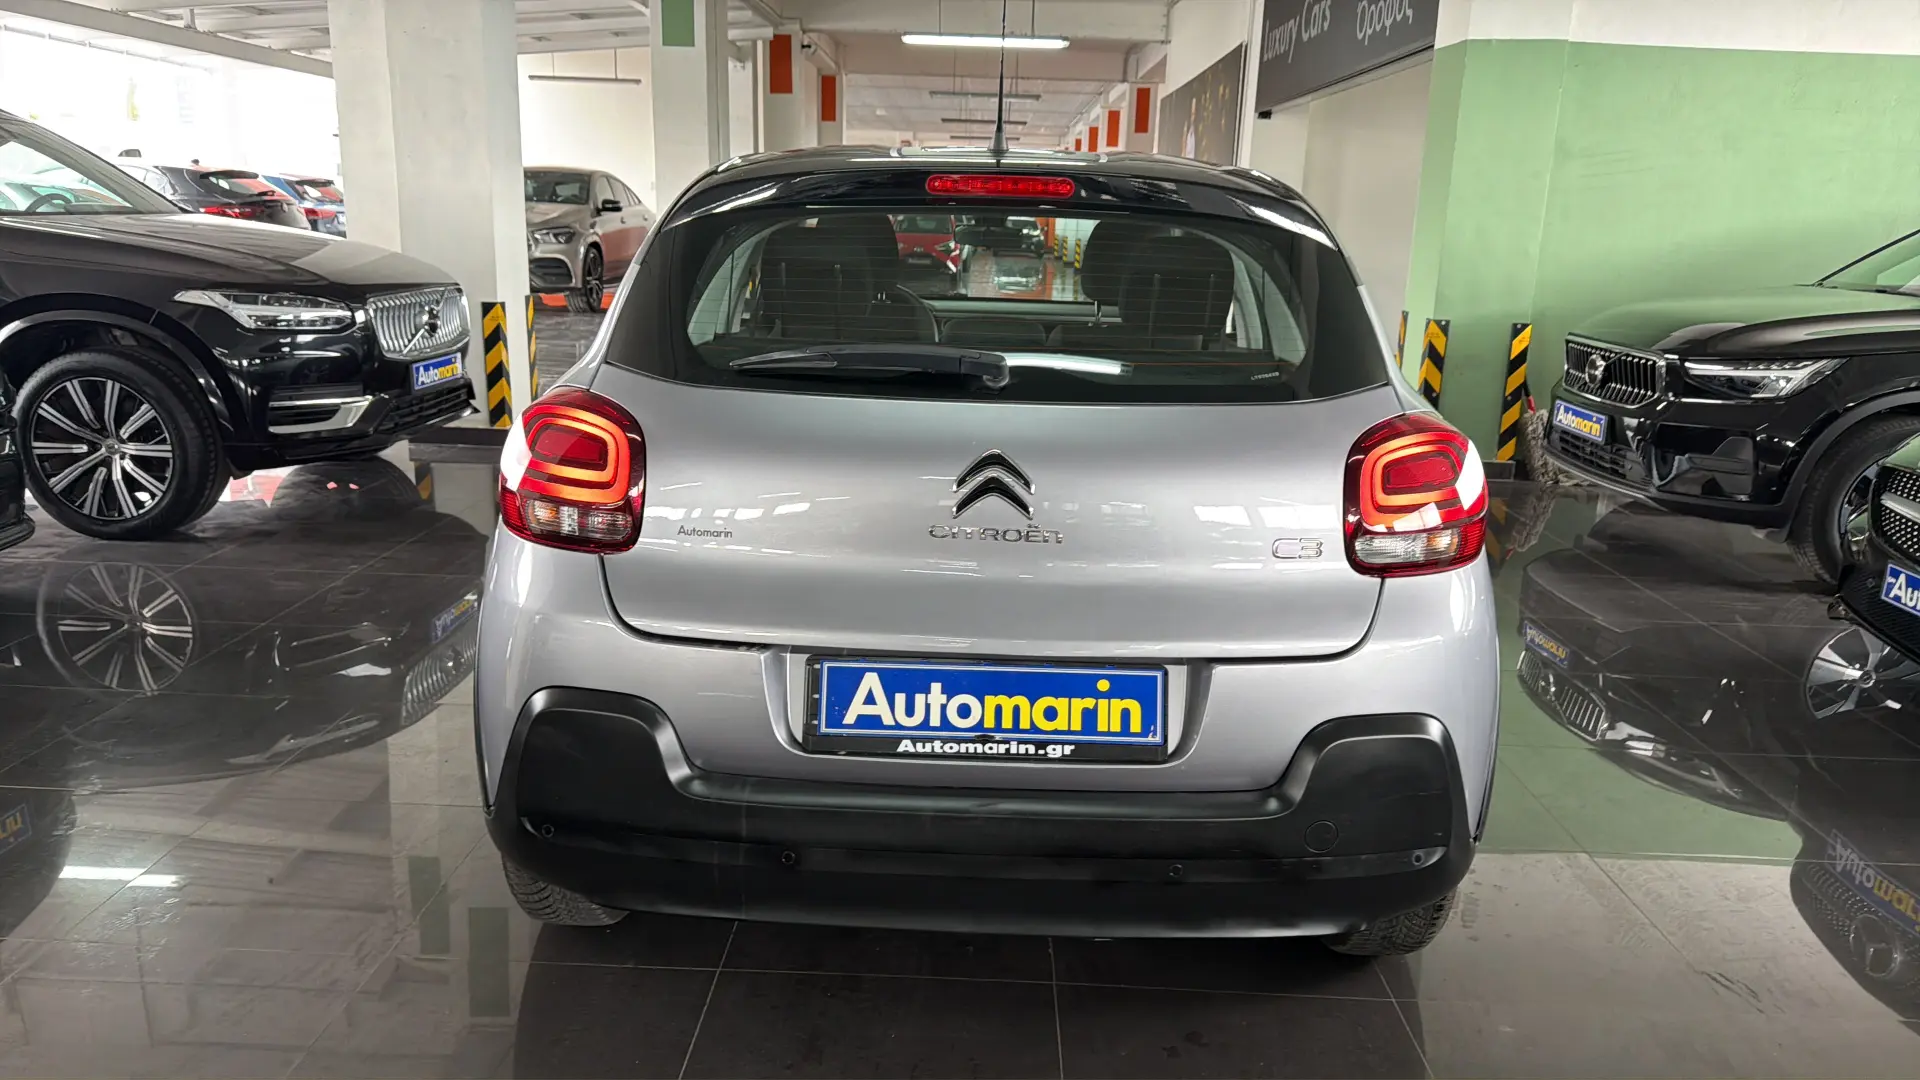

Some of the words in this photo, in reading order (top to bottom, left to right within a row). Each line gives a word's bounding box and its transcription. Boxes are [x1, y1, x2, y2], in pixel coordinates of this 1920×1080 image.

[1263, 14, 1300, 64] Luxury
[1301, 0, 1332, 42] Cars
[1556, 404, 1601, 437] Automarin
[677, 524, 733, 538] Automarin
[1271, 537, 1324, 559] C3
[842, 671, 1142, 733] Automarin
[896, 739, 1076, 757] Automarin.gr
